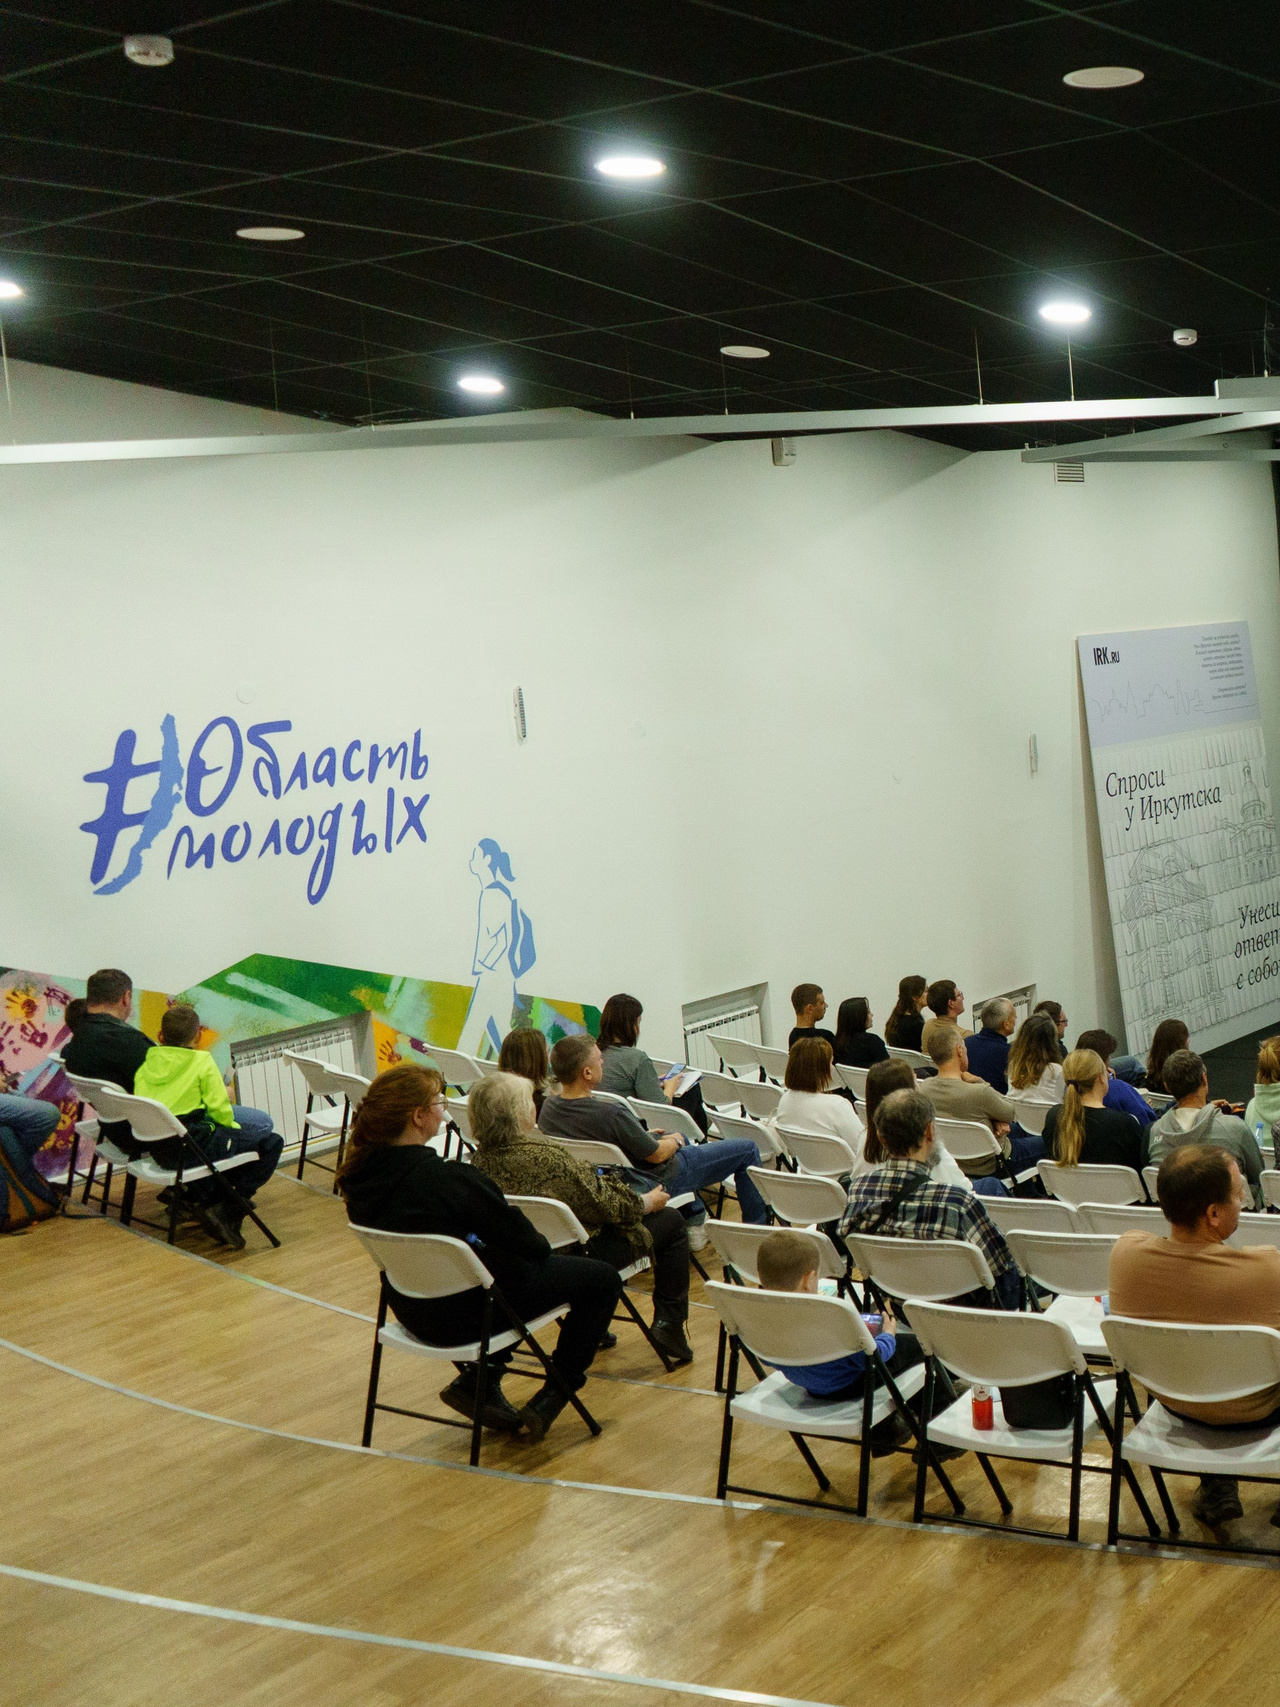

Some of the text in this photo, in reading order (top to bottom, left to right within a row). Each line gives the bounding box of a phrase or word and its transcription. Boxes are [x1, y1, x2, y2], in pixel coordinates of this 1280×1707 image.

[1093, 647, 1120, 665] IRK.RU
[1105, 769, 1165, 800] Спроси
[1125, 786, 1222, 831] у Иркутска
[167, 787, 430, 905] молодых
[1239, 901, 1280, 929] Унеси
[1236, 973, 1243, 989] с
